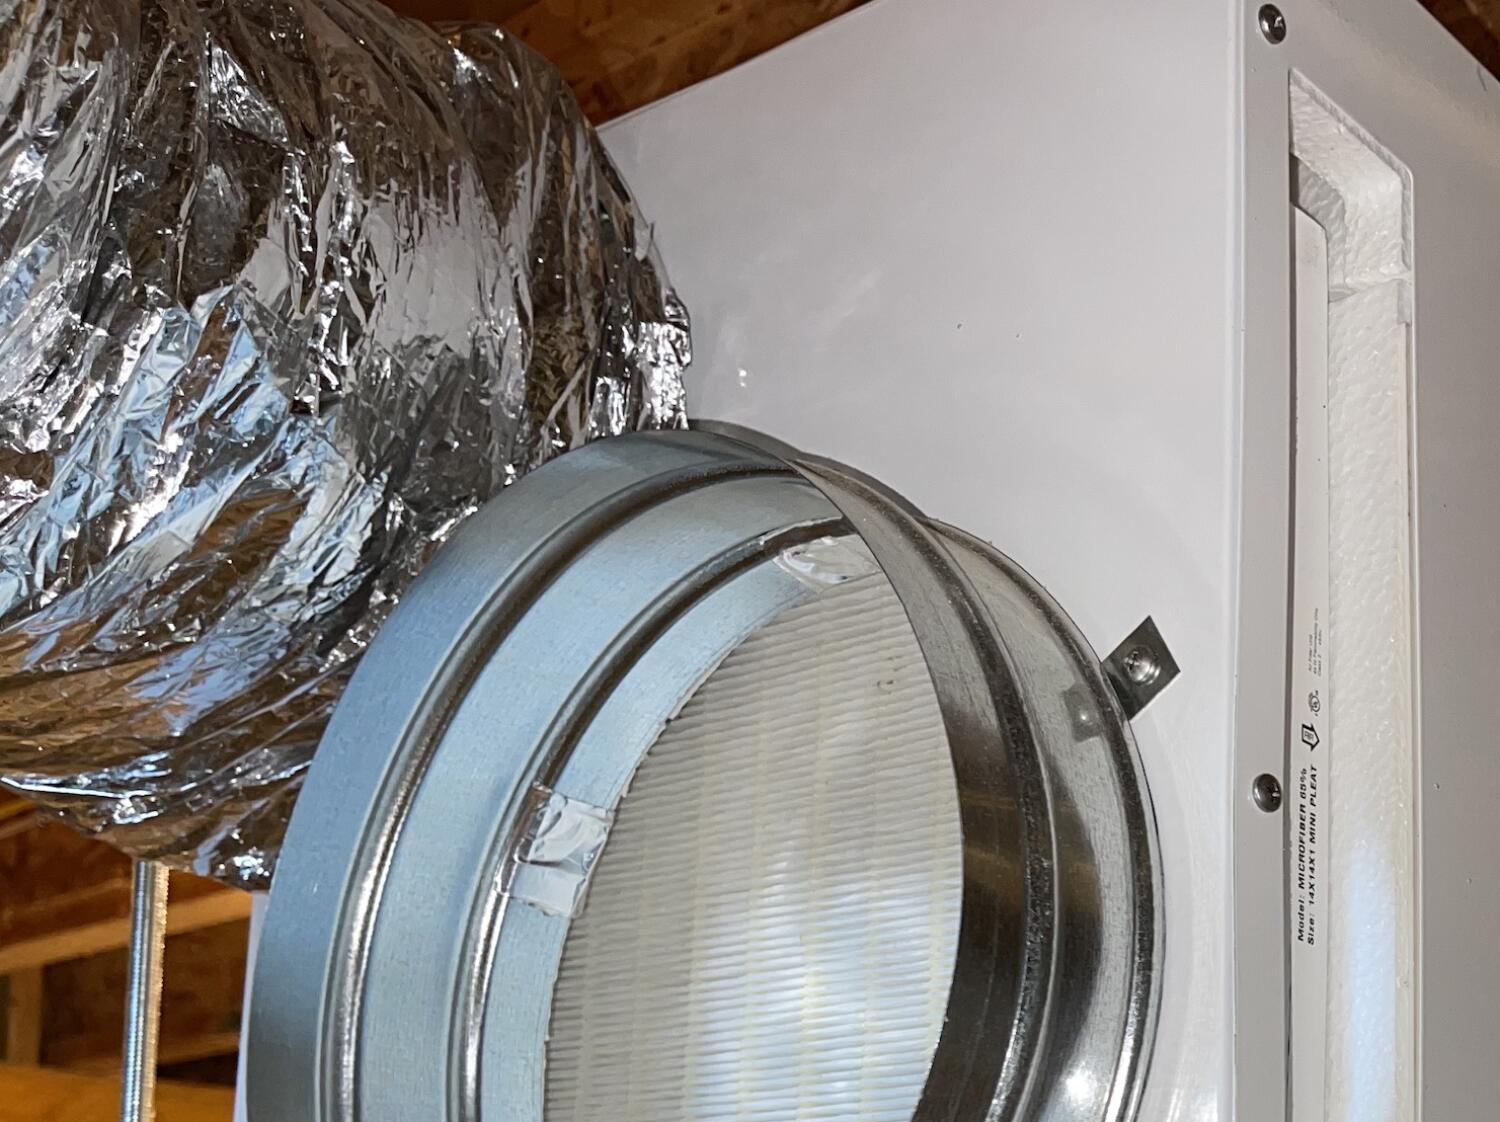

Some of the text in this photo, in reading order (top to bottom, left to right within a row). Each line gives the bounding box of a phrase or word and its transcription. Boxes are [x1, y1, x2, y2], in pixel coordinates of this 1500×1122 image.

[1309, 764, 1318, 807] PLEAT
[1298, 804, 1307, 889] MICROFIBER
[1309, 812, 1317, 844] MINI
[1308, 850, 1316, 905] 14X14X1
